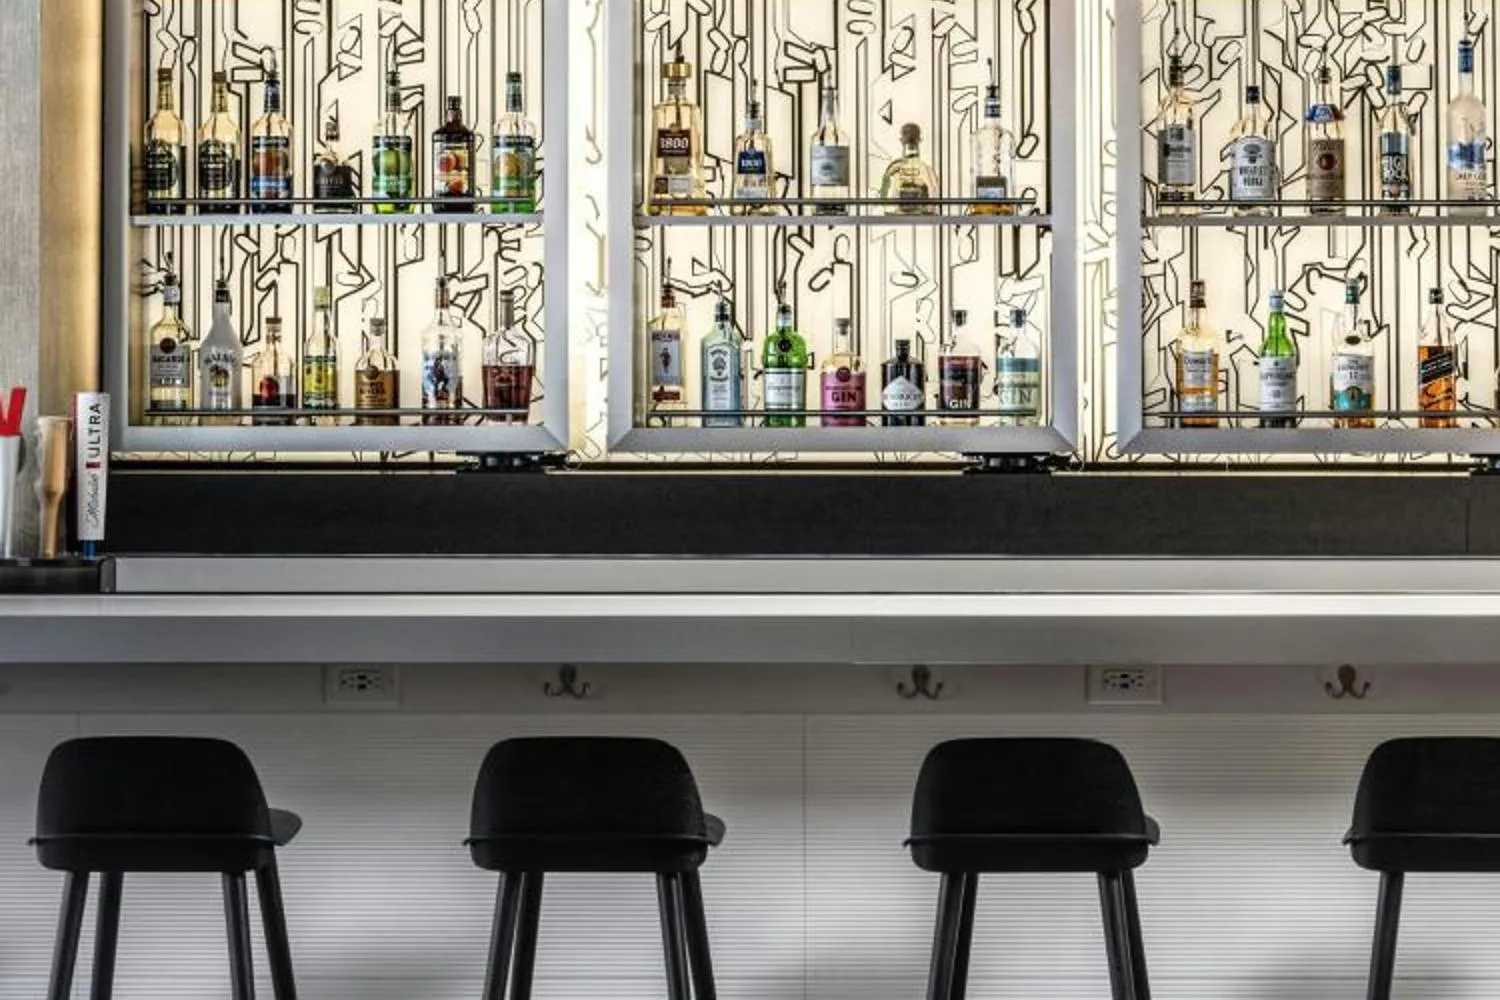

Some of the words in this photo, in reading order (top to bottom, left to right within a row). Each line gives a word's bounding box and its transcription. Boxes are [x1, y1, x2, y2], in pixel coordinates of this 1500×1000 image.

[659, 137, 689, 149] 1800
[831, 391, 857, 403] GIN
[88, 402, 101, 459] ULTRA
